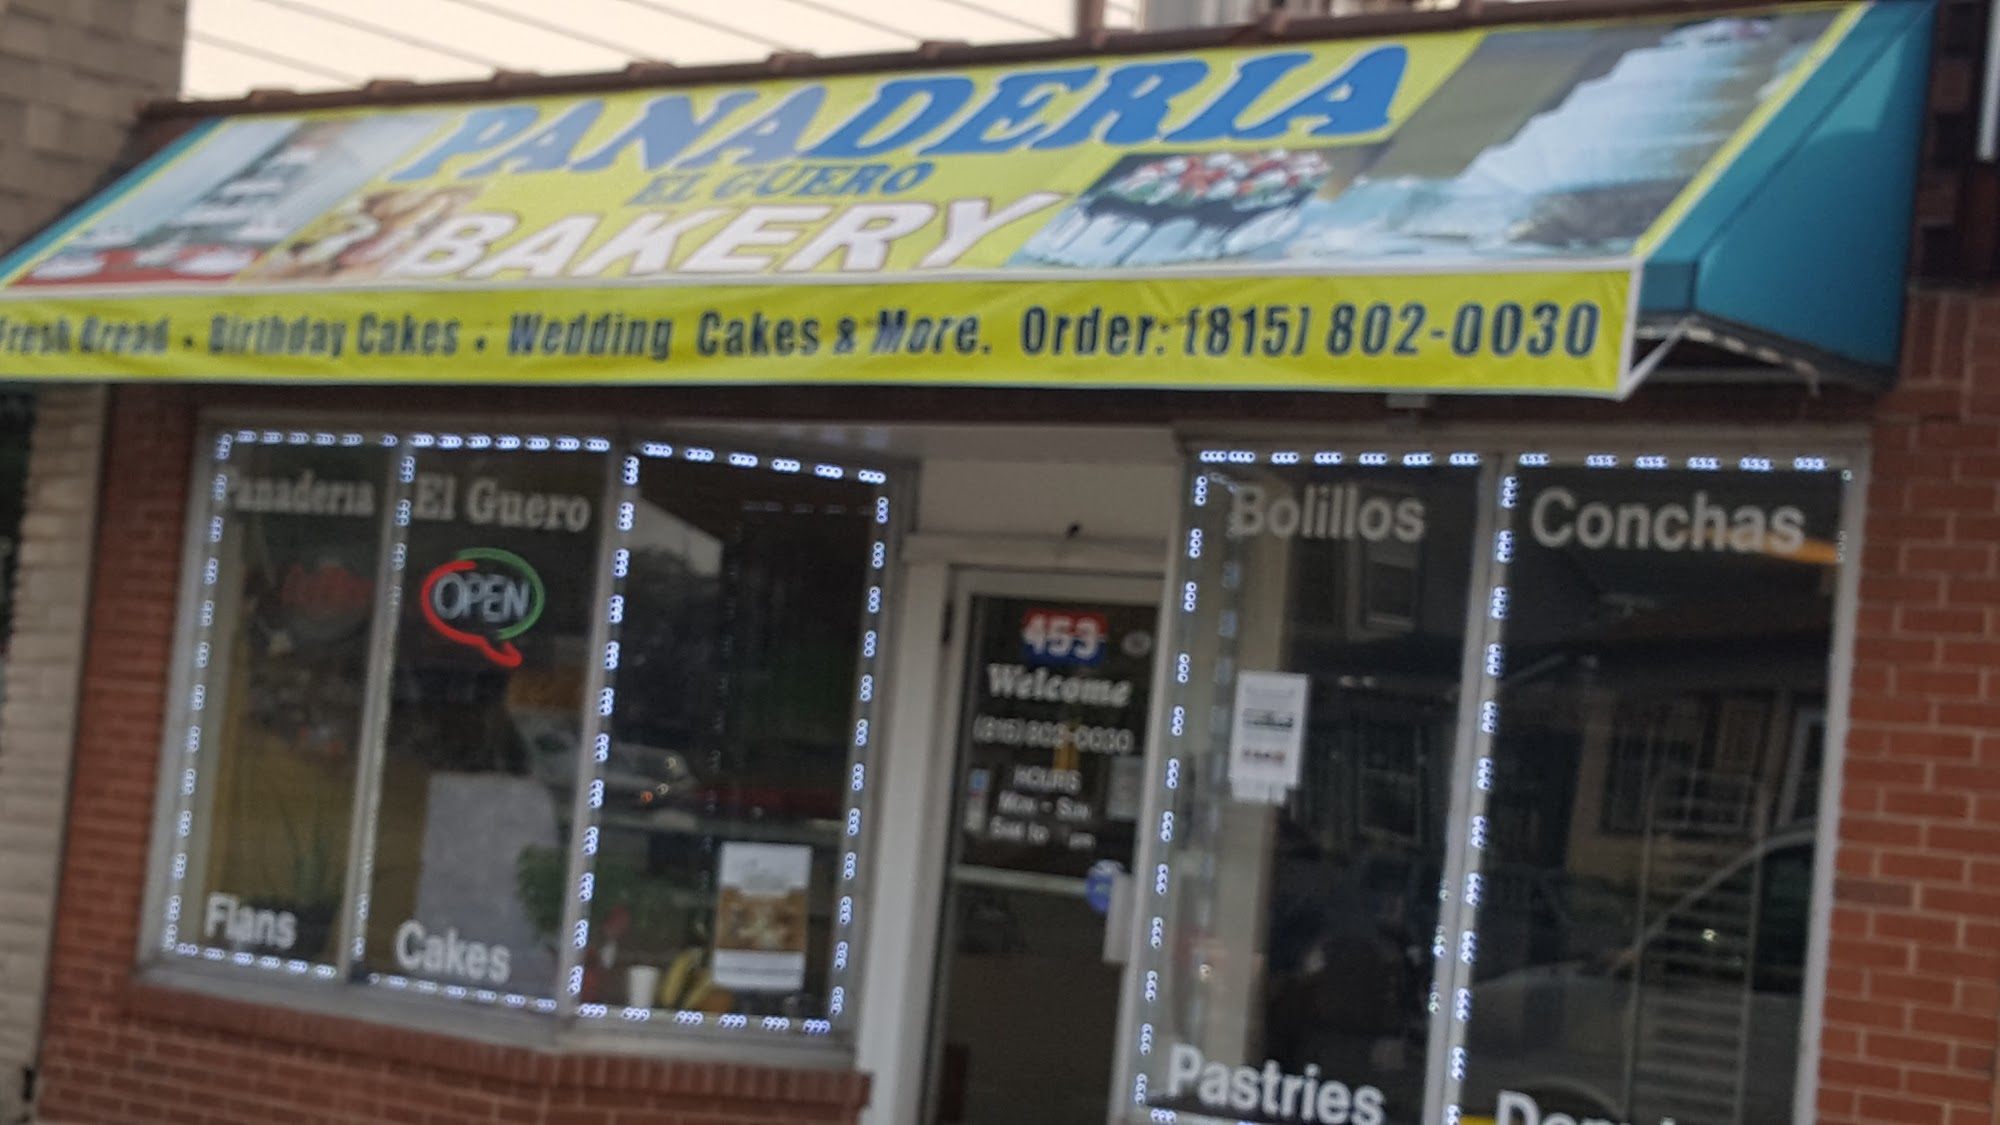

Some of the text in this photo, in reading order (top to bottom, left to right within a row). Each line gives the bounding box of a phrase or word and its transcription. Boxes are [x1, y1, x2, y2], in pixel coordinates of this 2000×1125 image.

[394, 45, 1410, 180] PANADERIA
[630, 158, 938, 206] EL GUERO
[400, 190, 1066, 279] BAKERY
[208, 313, 346, 358] Birthday
[355, 311, 460, 357] Cakes
[507, 311, 673, 362] Wedding
[697, 311, 820, 358] Cakes
[833, 318, 858, 356] &
[868, 311, 993, 356] More.
[1019, 305, 1170, 357] Order:
[1183, 305, 1309, 357] (815)
[1326, 302, 1602, 358] 802-0030
[414, 473, 593, 534] El Guero
[1227, 483, 1426, 543] Bolillos
[1529, 487, 1807, 553] Conchas
[433, 572, 531, 623] OPEN
[1023, 612, 1100, 659] 453
[987, 663, 1133, 708] Welcome
[204, 892, 297, 950] Flans
[394, 919, 512, 983] Cakes
[1167, 1043, 1386, 1125] Pastries
